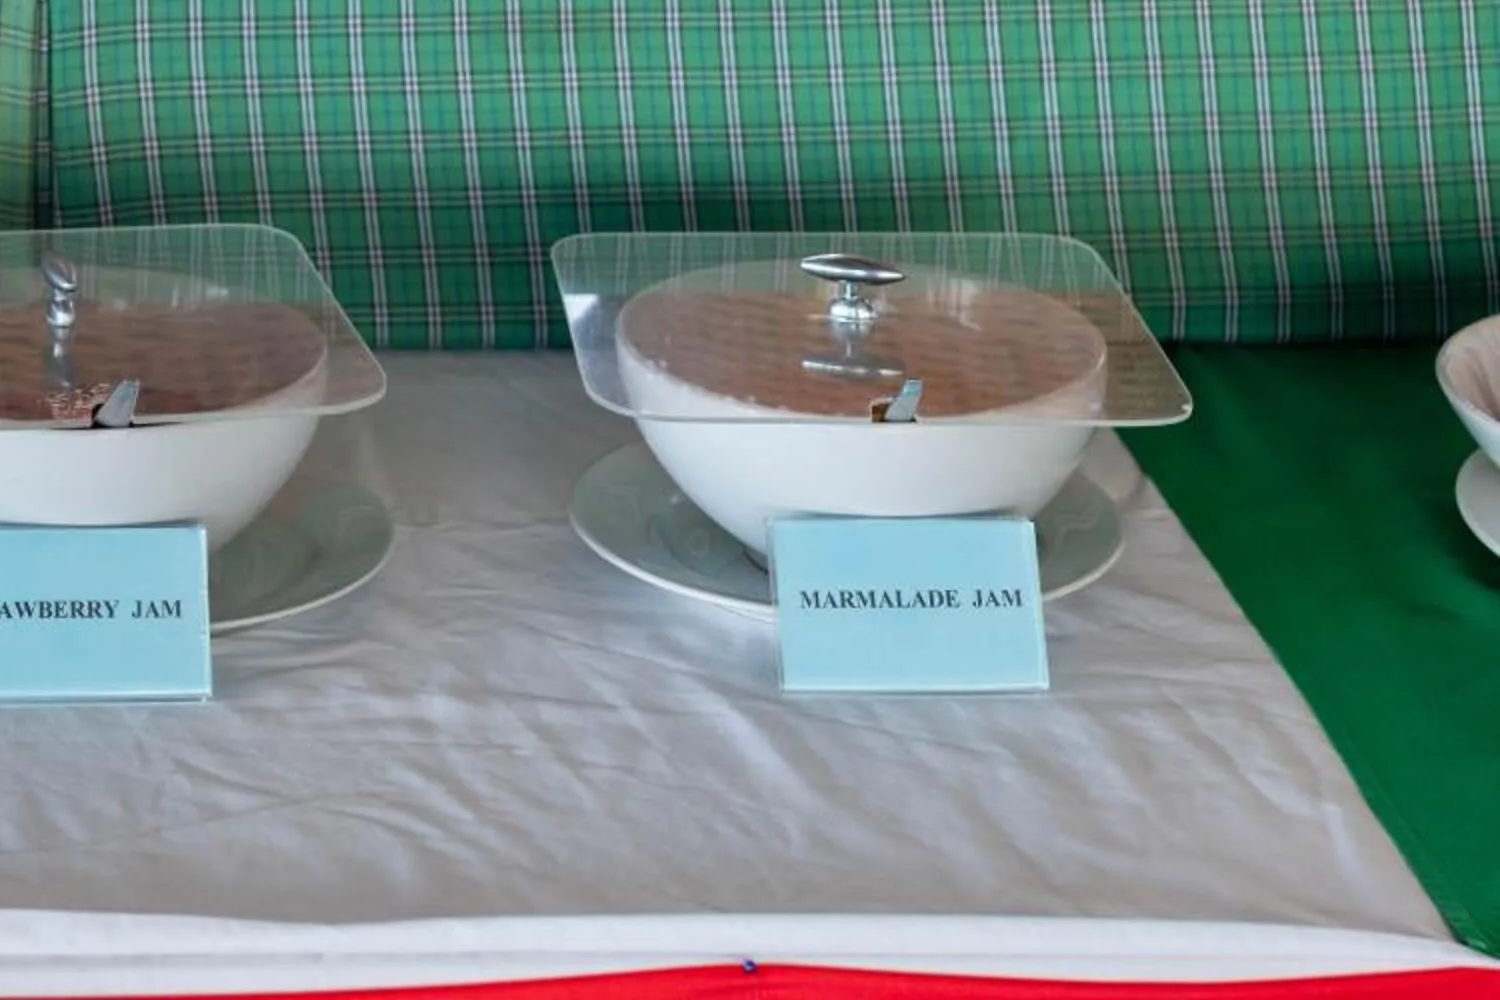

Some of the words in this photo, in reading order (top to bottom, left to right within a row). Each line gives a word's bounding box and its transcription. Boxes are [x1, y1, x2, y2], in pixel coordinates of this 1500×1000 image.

[800, 589, 960, 609] MARMALADE
[971, 588, 1023, 608] JAM
[131, 599, 182, 619] JAM
